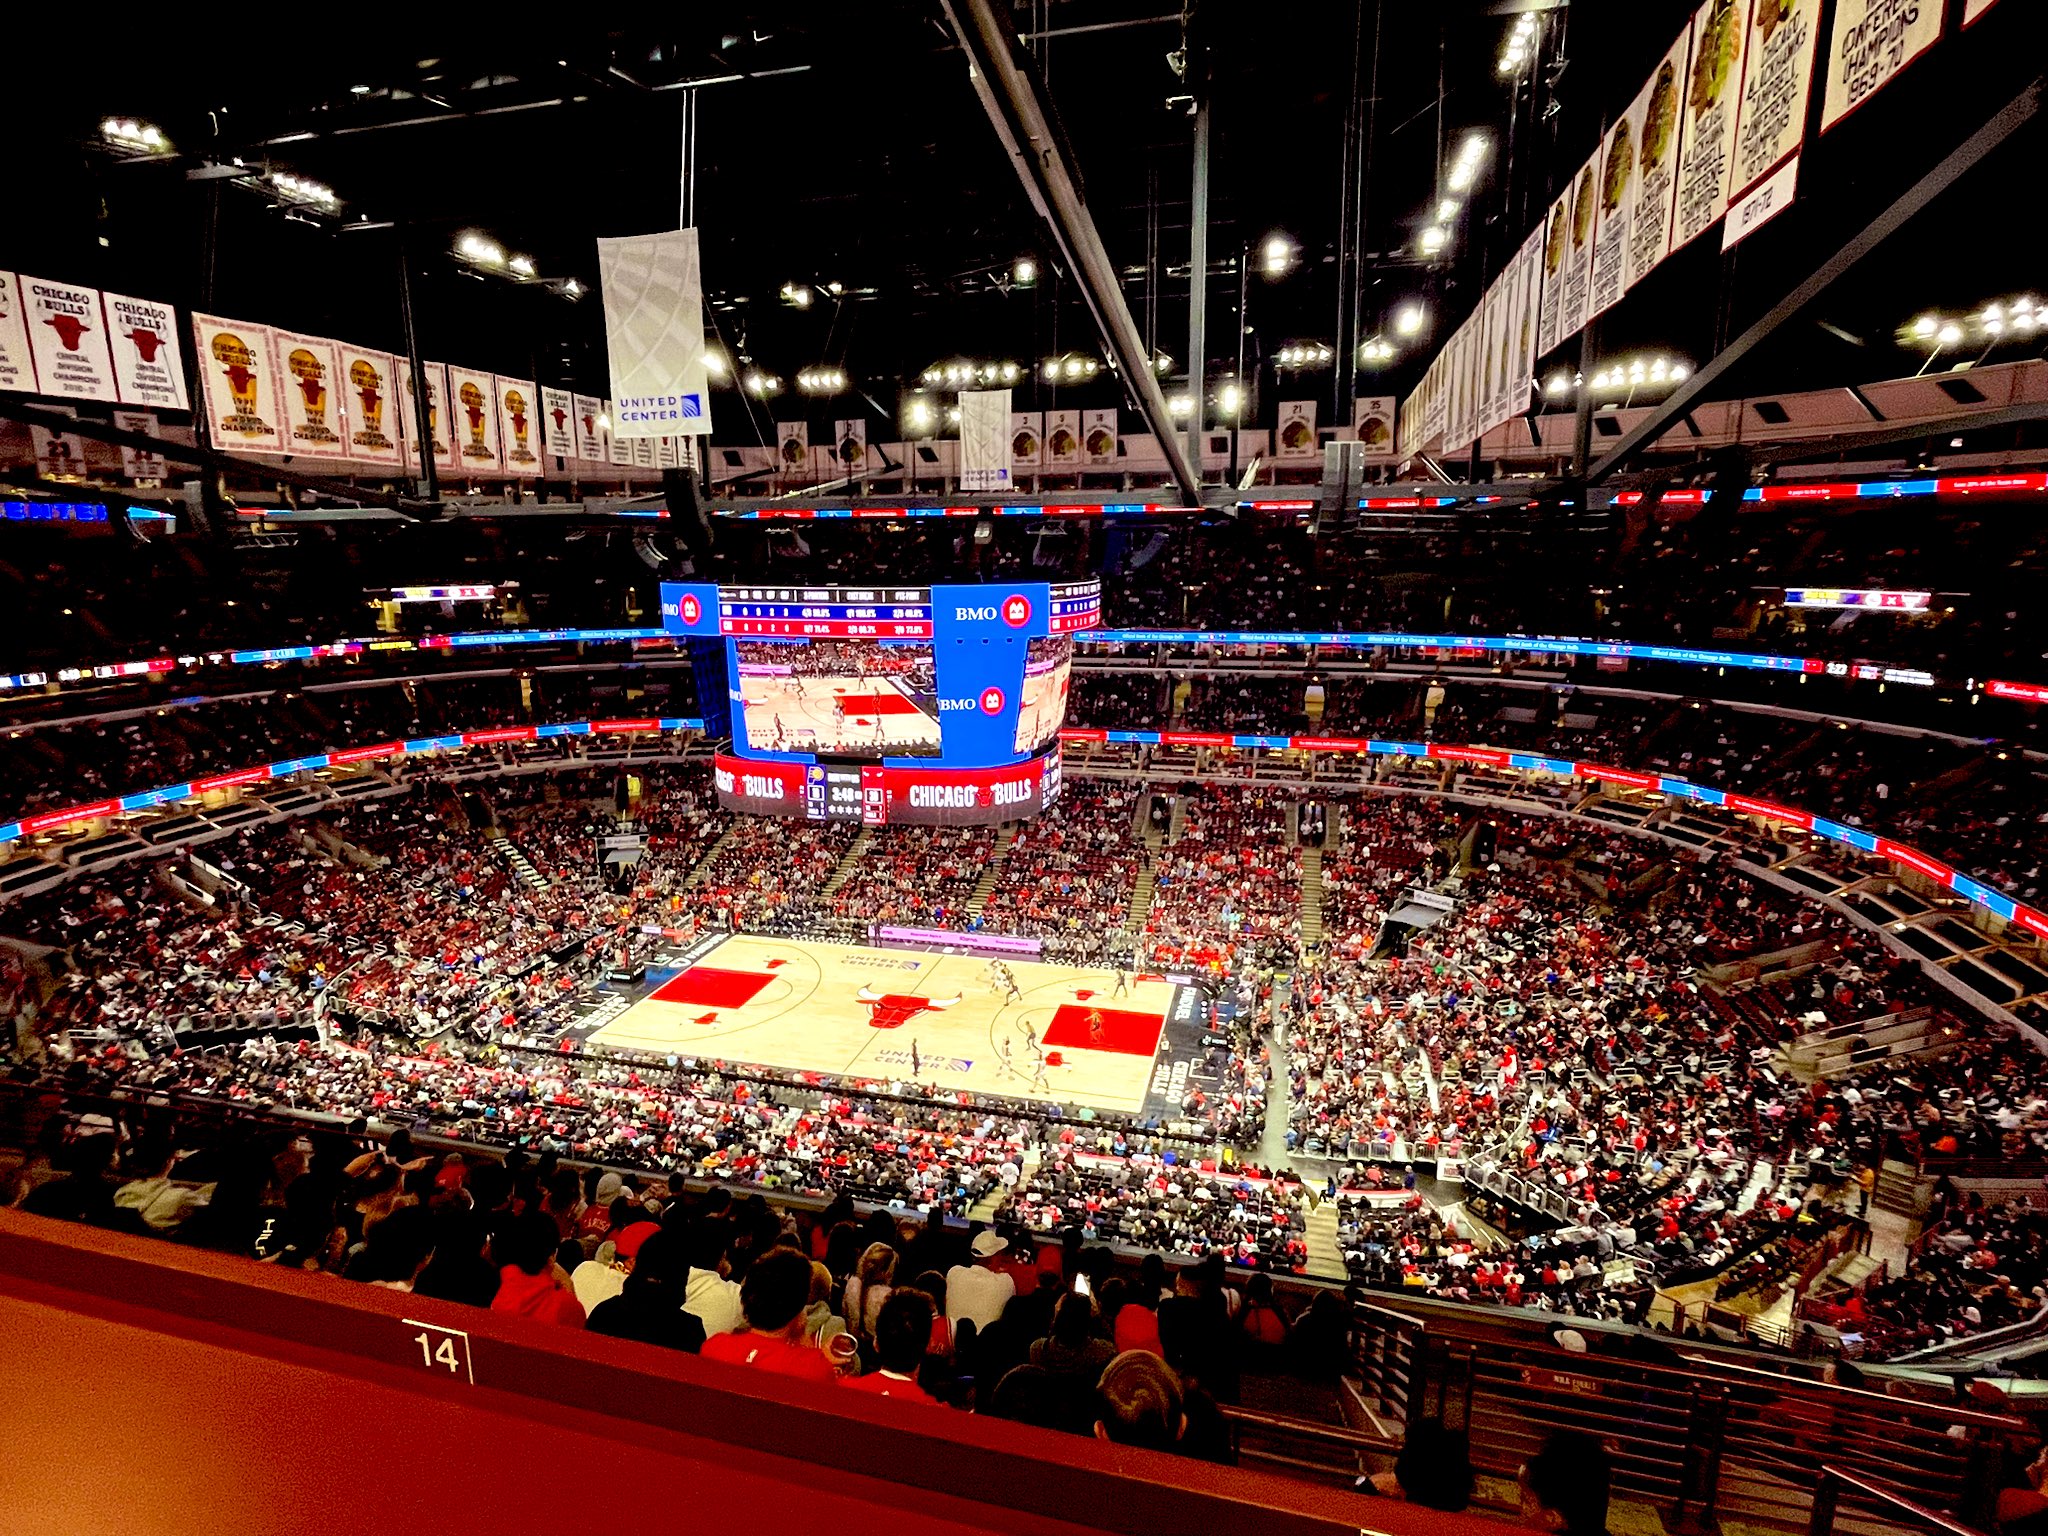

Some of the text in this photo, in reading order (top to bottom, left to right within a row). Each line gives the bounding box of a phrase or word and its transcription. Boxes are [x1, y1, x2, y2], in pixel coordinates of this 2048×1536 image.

[33, 285, 90, 305] CHICAGO
[44, 299, 85, 315] BULLS
[115, 301, 167, 320] CHICAGO
[125, 314, 161, 330] BULLS
[620, 396, 677, 409] UNITED
[621, 410, 678, 422] CENTER
[221, 423, 275, 436] CHAMPIONS
[294, 432, 340, 443] CHAMPIONS
[955, 607, 998, 621] BMO
[940, 699, 976, 711] BMO
[743, 773, 784, 801] BULLS
[909, 784, 978, 808] CHICAGO
[991, 778, 1031, 805] BULLS
[841, 960, 895, 969] CENTER
[845, 954, 900, 964] UNITED
[1175, 986, 1197, 1020] FANDUEL
[880, 1049, 946, 1062] UNIED
[1151, 1063, 1171, 1095] BULLS
[1165, 1061, 1189, 1104] CHICAGO
[414, 1332, 459, 1373] 14
